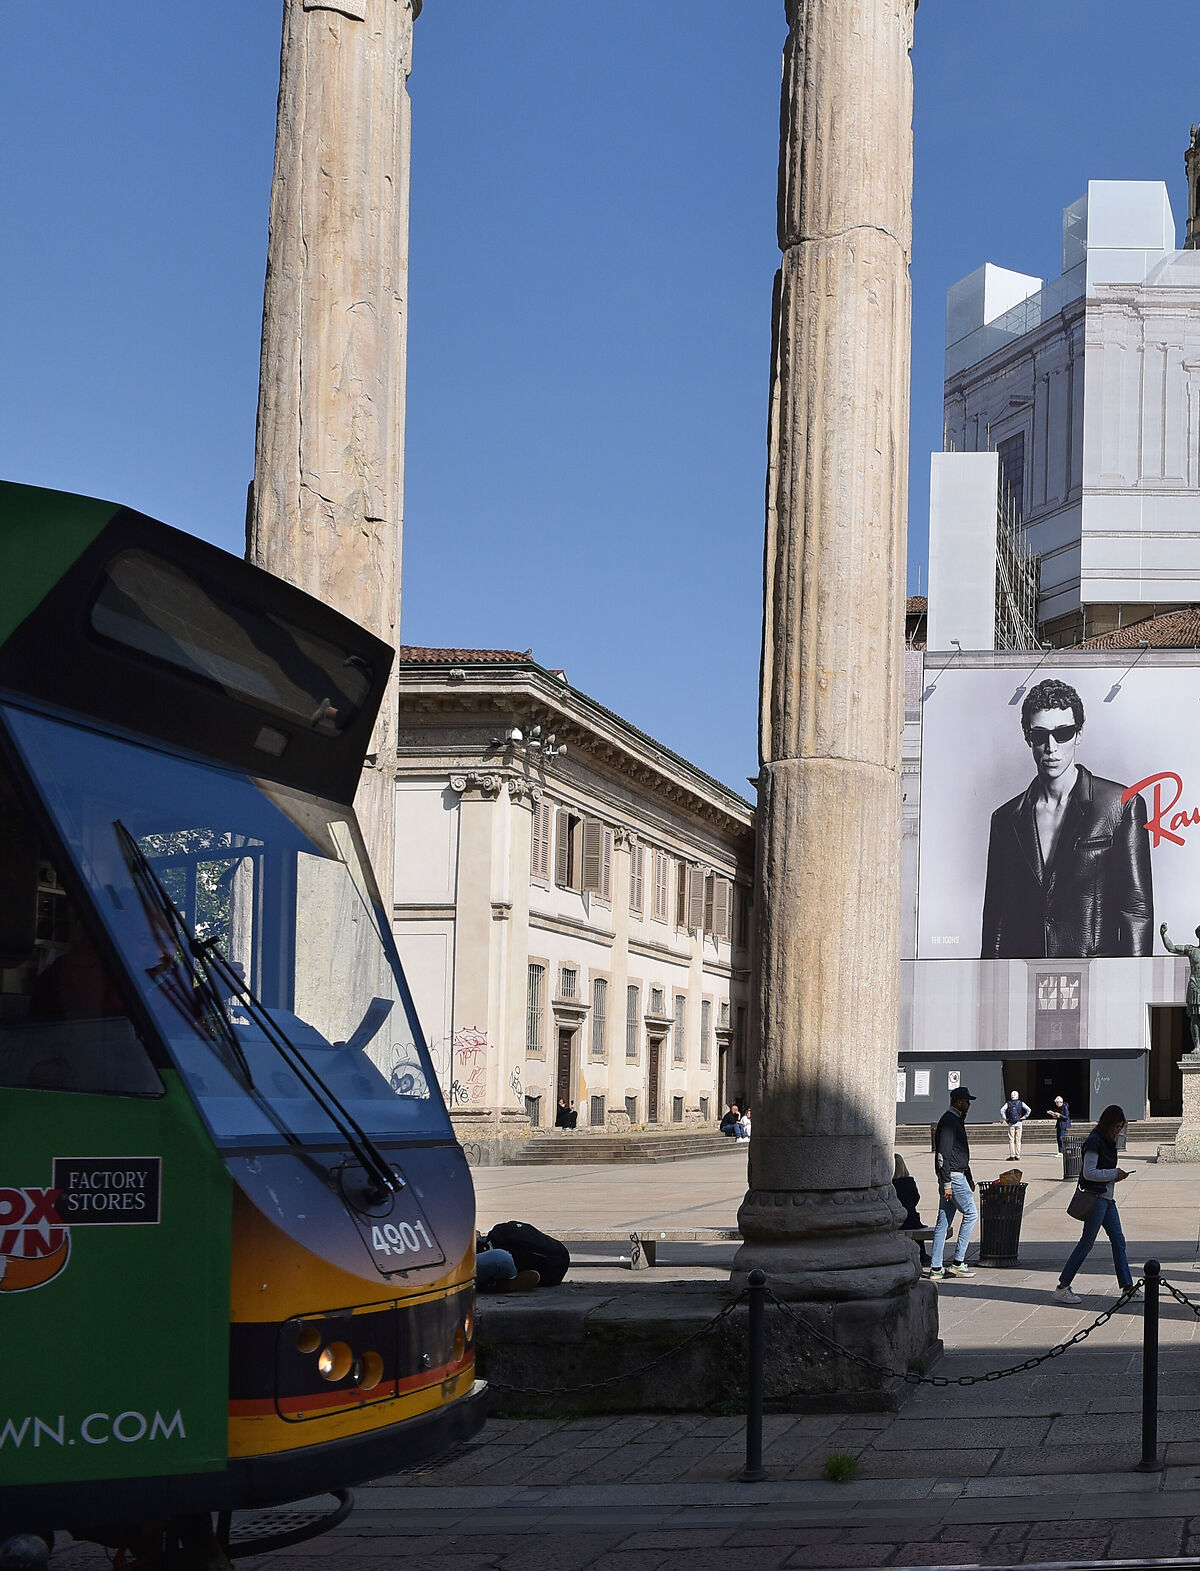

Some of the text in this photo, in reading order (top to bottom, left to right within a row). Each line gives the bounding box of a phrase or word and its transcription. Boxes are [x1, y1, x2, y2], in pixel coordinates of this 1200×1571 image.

[69, 1172, 148, 1188] FACTORY
[68, 1193, 146, 1211] STORES
[372, 1220, 433, 1255] 4901
